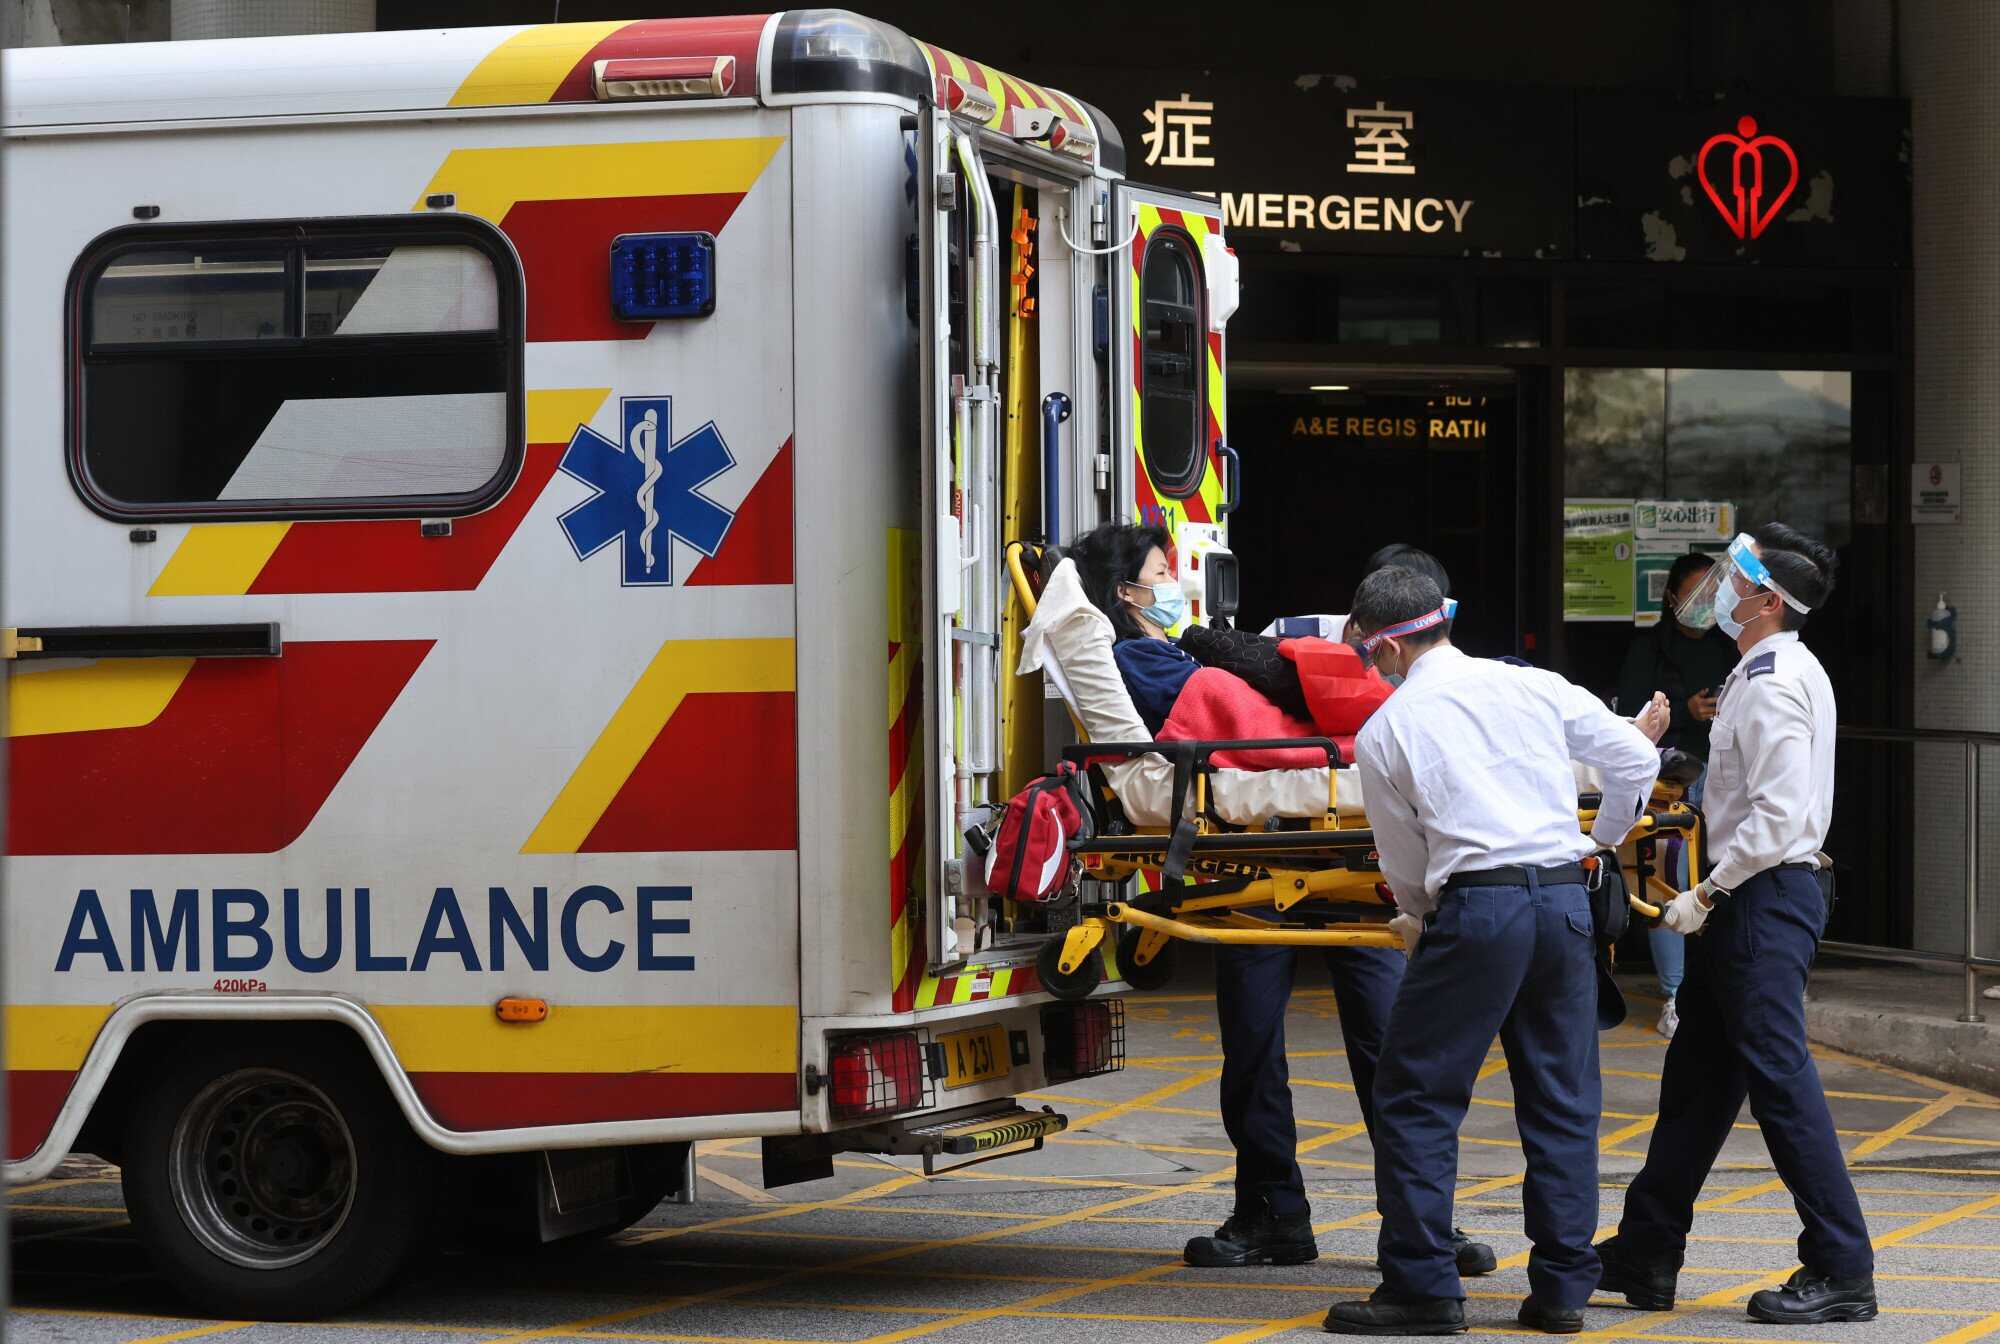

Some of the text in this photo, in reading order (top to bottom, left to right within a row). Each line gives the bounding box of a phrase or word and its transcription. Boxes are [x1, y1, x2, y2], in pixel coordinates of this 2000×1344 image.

[1141, 93, 1416, 174] 症 室
[1191, 192, 1474, 233] MERGENCY
[1293, 417, 1339, 436] A&E
[1658, 506, 1716, 524] 安心出行
[54, 885, 695, 973] AMBULANCE
[213, 978, 267, 992] 420kPa
[969, 1034, 994, 1076] 231
